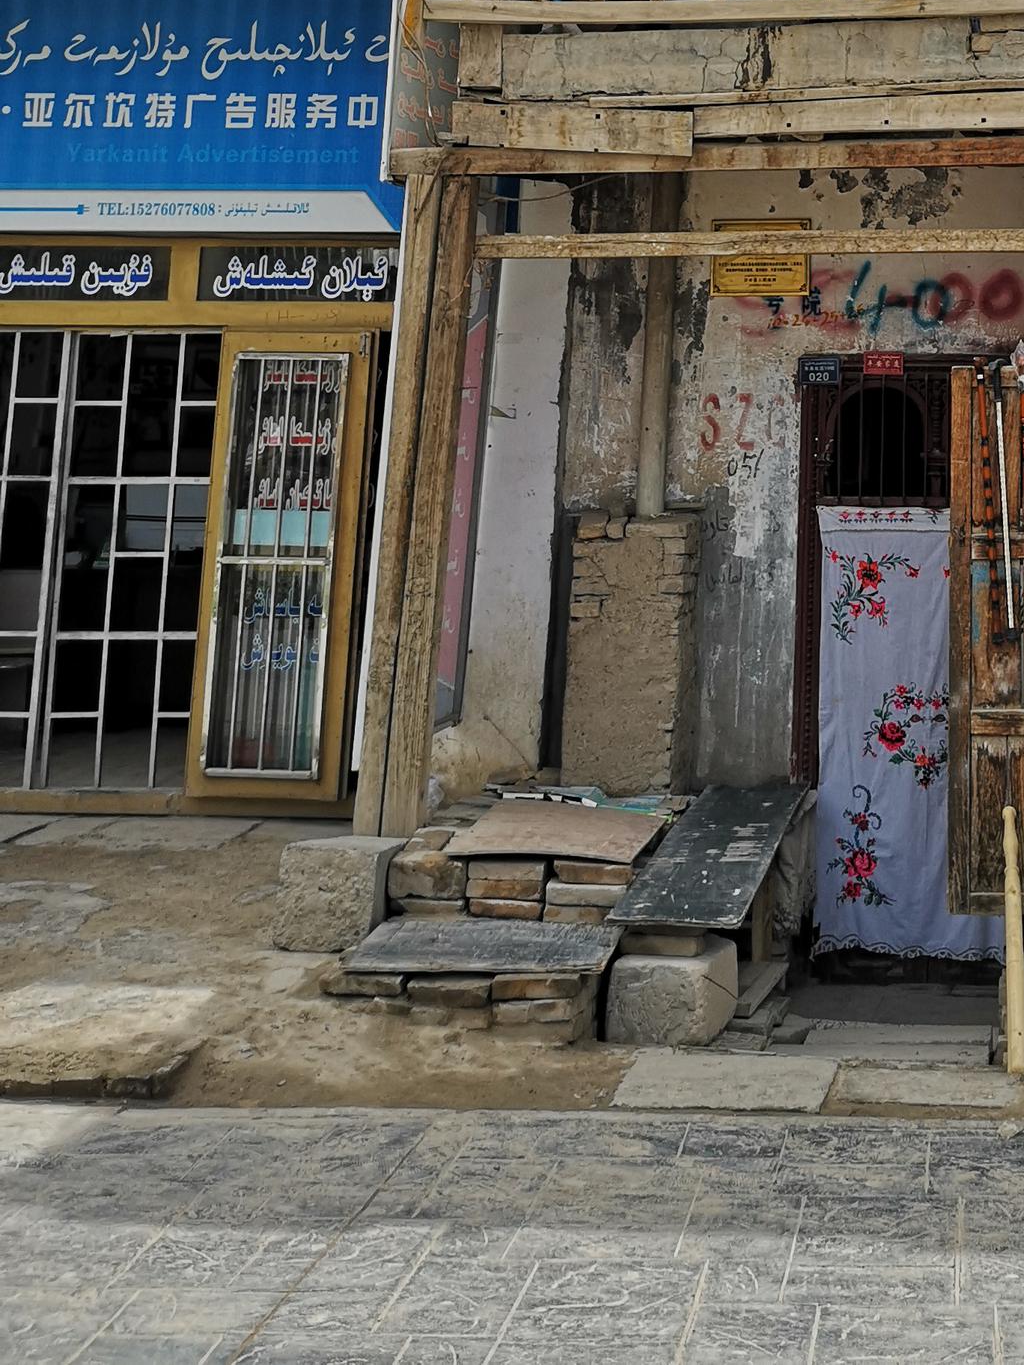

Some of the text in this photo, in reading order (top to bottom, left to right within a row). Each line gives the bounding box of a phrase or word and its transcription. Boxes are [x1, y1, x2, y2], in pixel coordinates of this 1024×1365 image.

[177, 142, 360, 164] Advertisement
[97, 203, 215, 216] TEL:15276077808
[808, 372, 830, 382] 020
